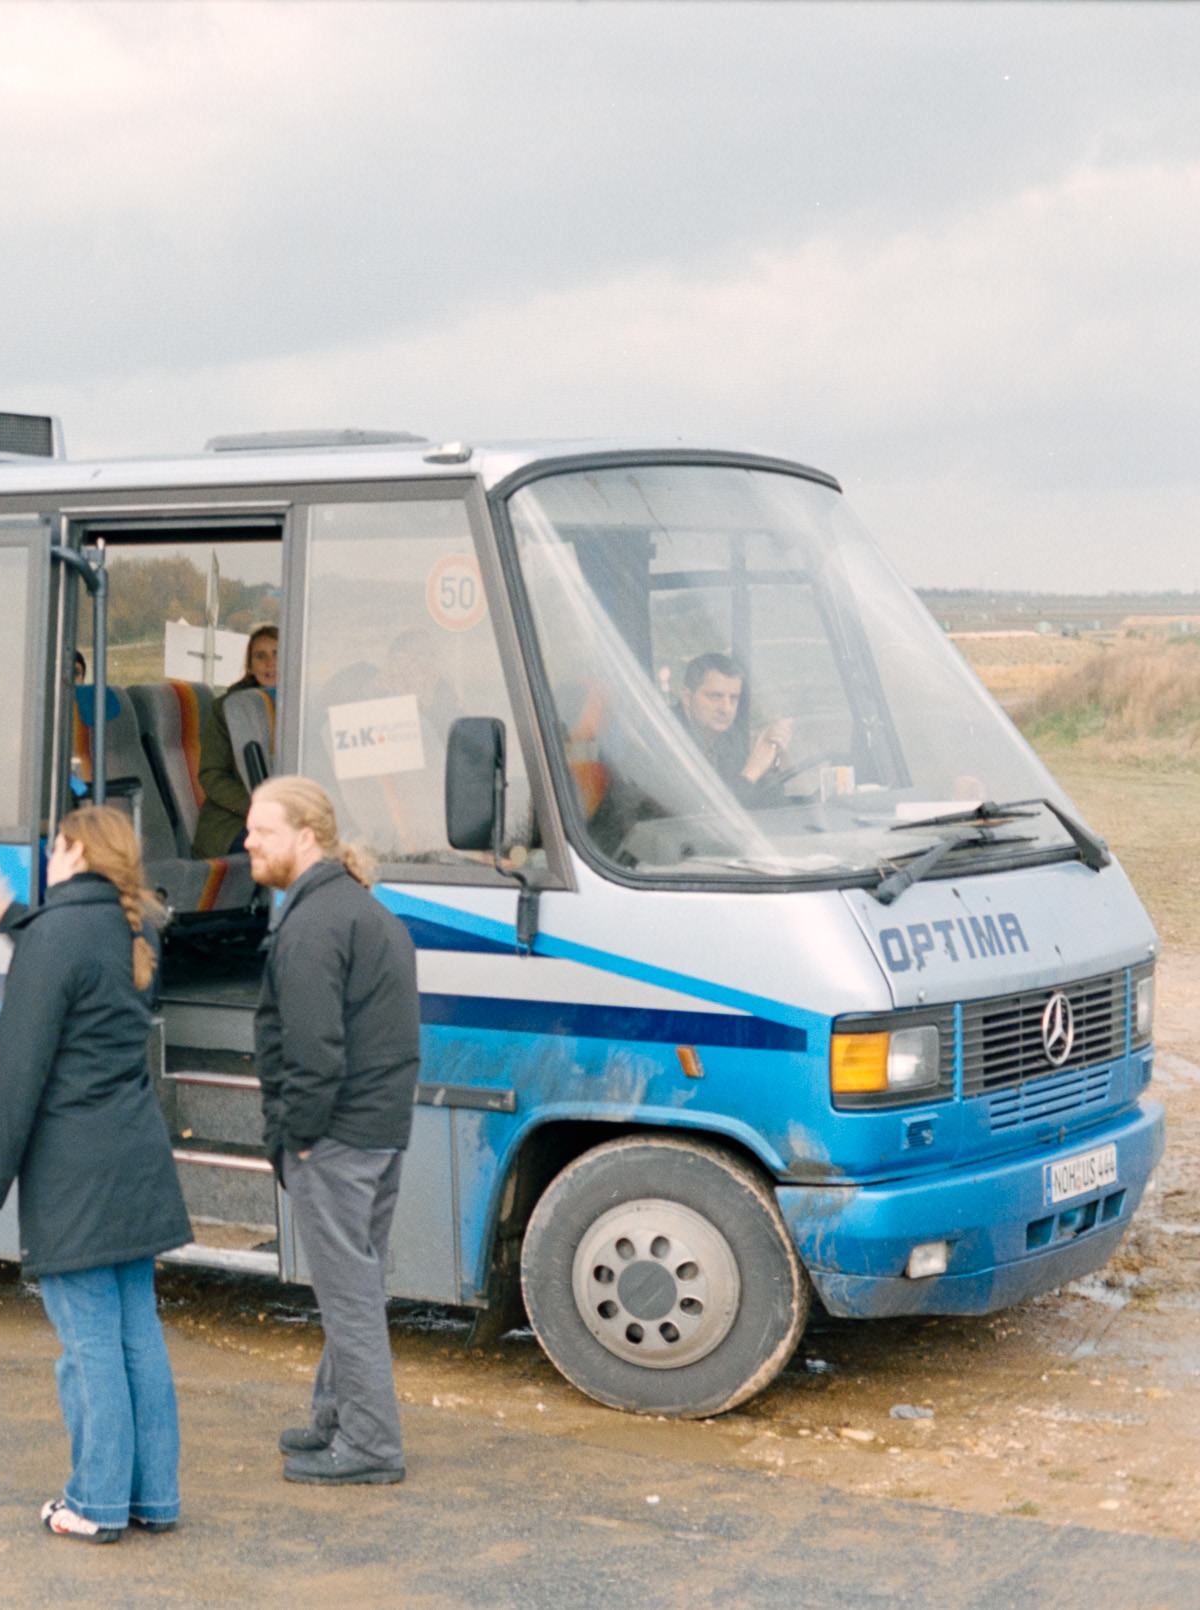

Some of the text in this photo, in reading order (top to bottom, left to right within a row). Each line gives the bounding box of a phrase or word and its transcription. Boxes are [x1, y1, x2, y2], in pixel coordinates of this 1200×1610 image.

[440, 576, 475, 610] 50
[879, 913, 1030, 973] OPTIMA
[1053, 1163, 1077, 1197] NOH
[1082, 1157, 1096, 1187] US
